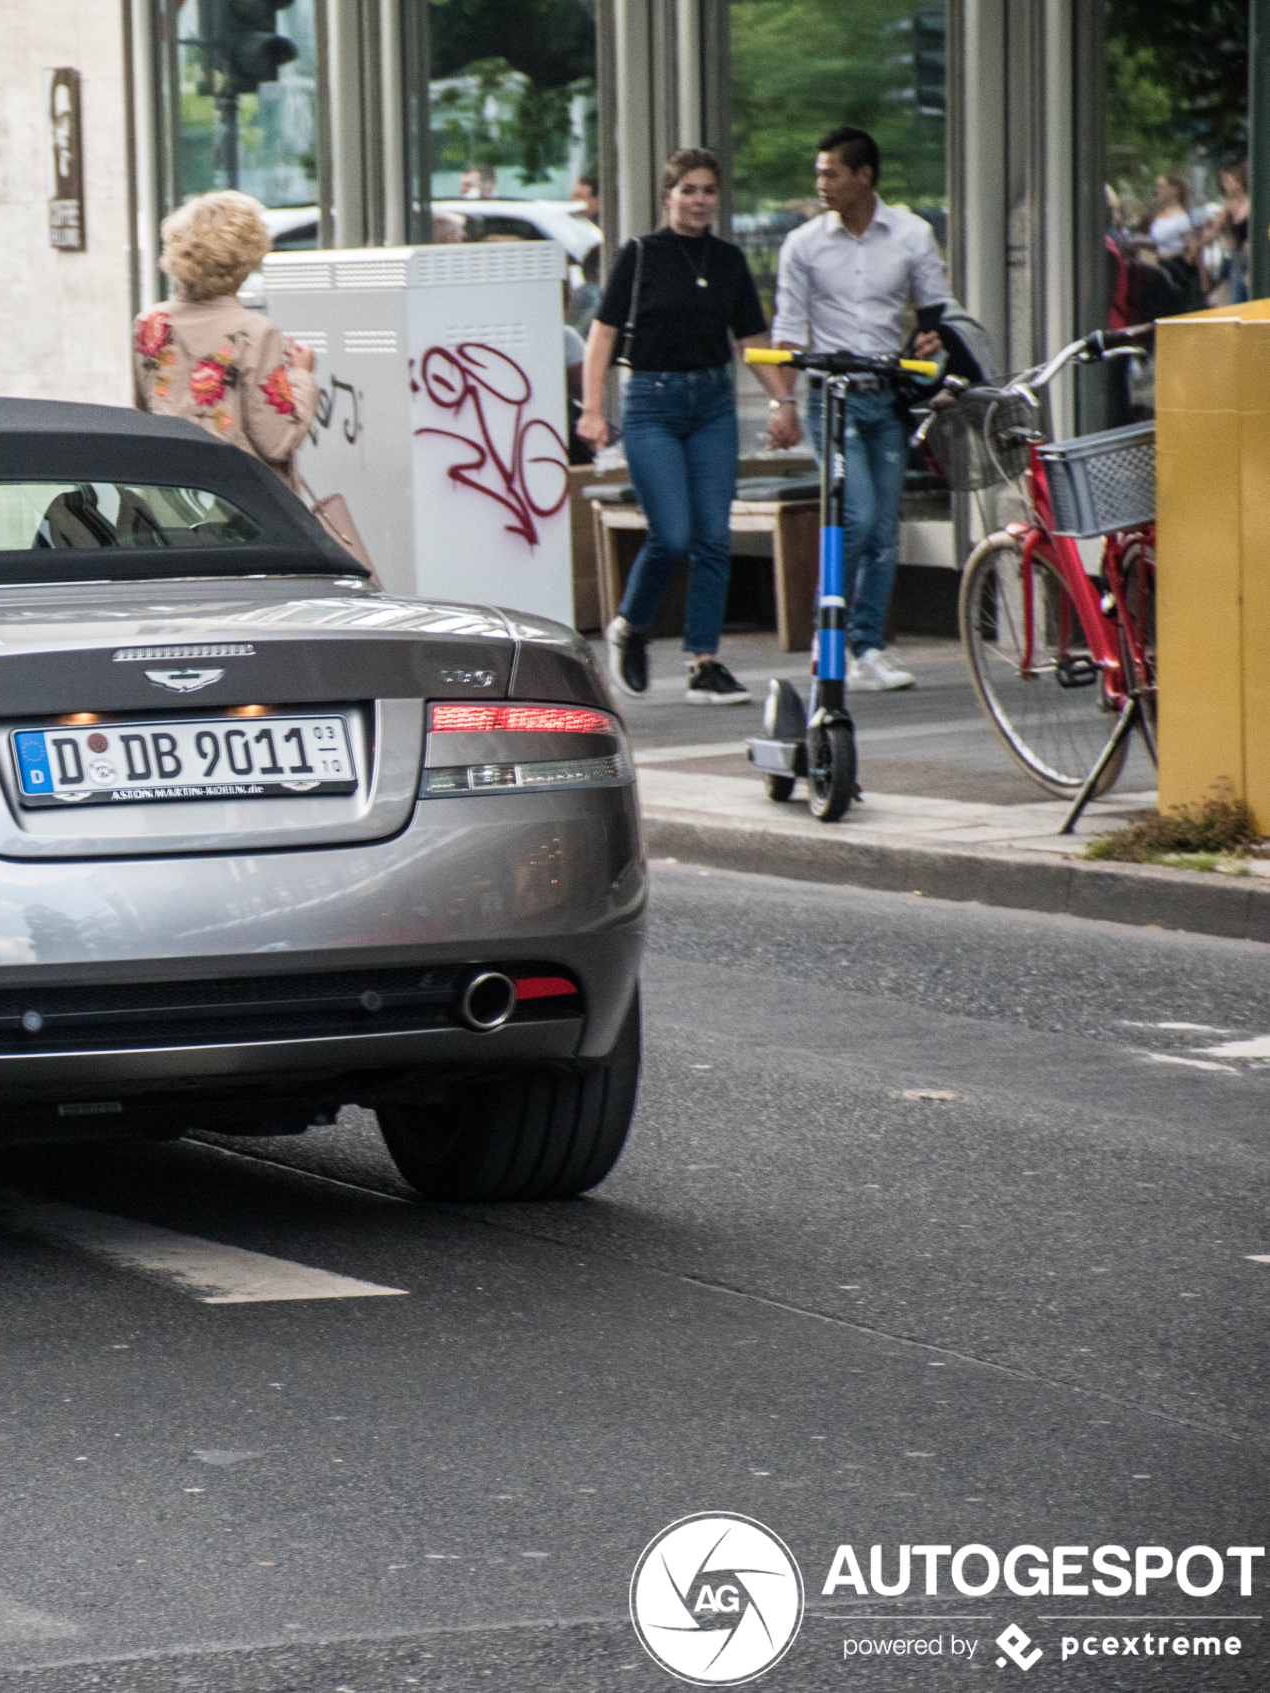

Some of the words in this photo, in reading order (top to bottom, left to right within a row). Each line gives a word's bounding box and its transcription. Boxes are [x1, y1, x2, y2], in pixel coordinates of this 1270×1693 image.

[51, 738, 84, 785] D
[119, 732, 183, 781] DB
[195, 727, 314, 777] 9011
[30, 769, 45, 784] D
[112, 789, 154, 800] ASTON
